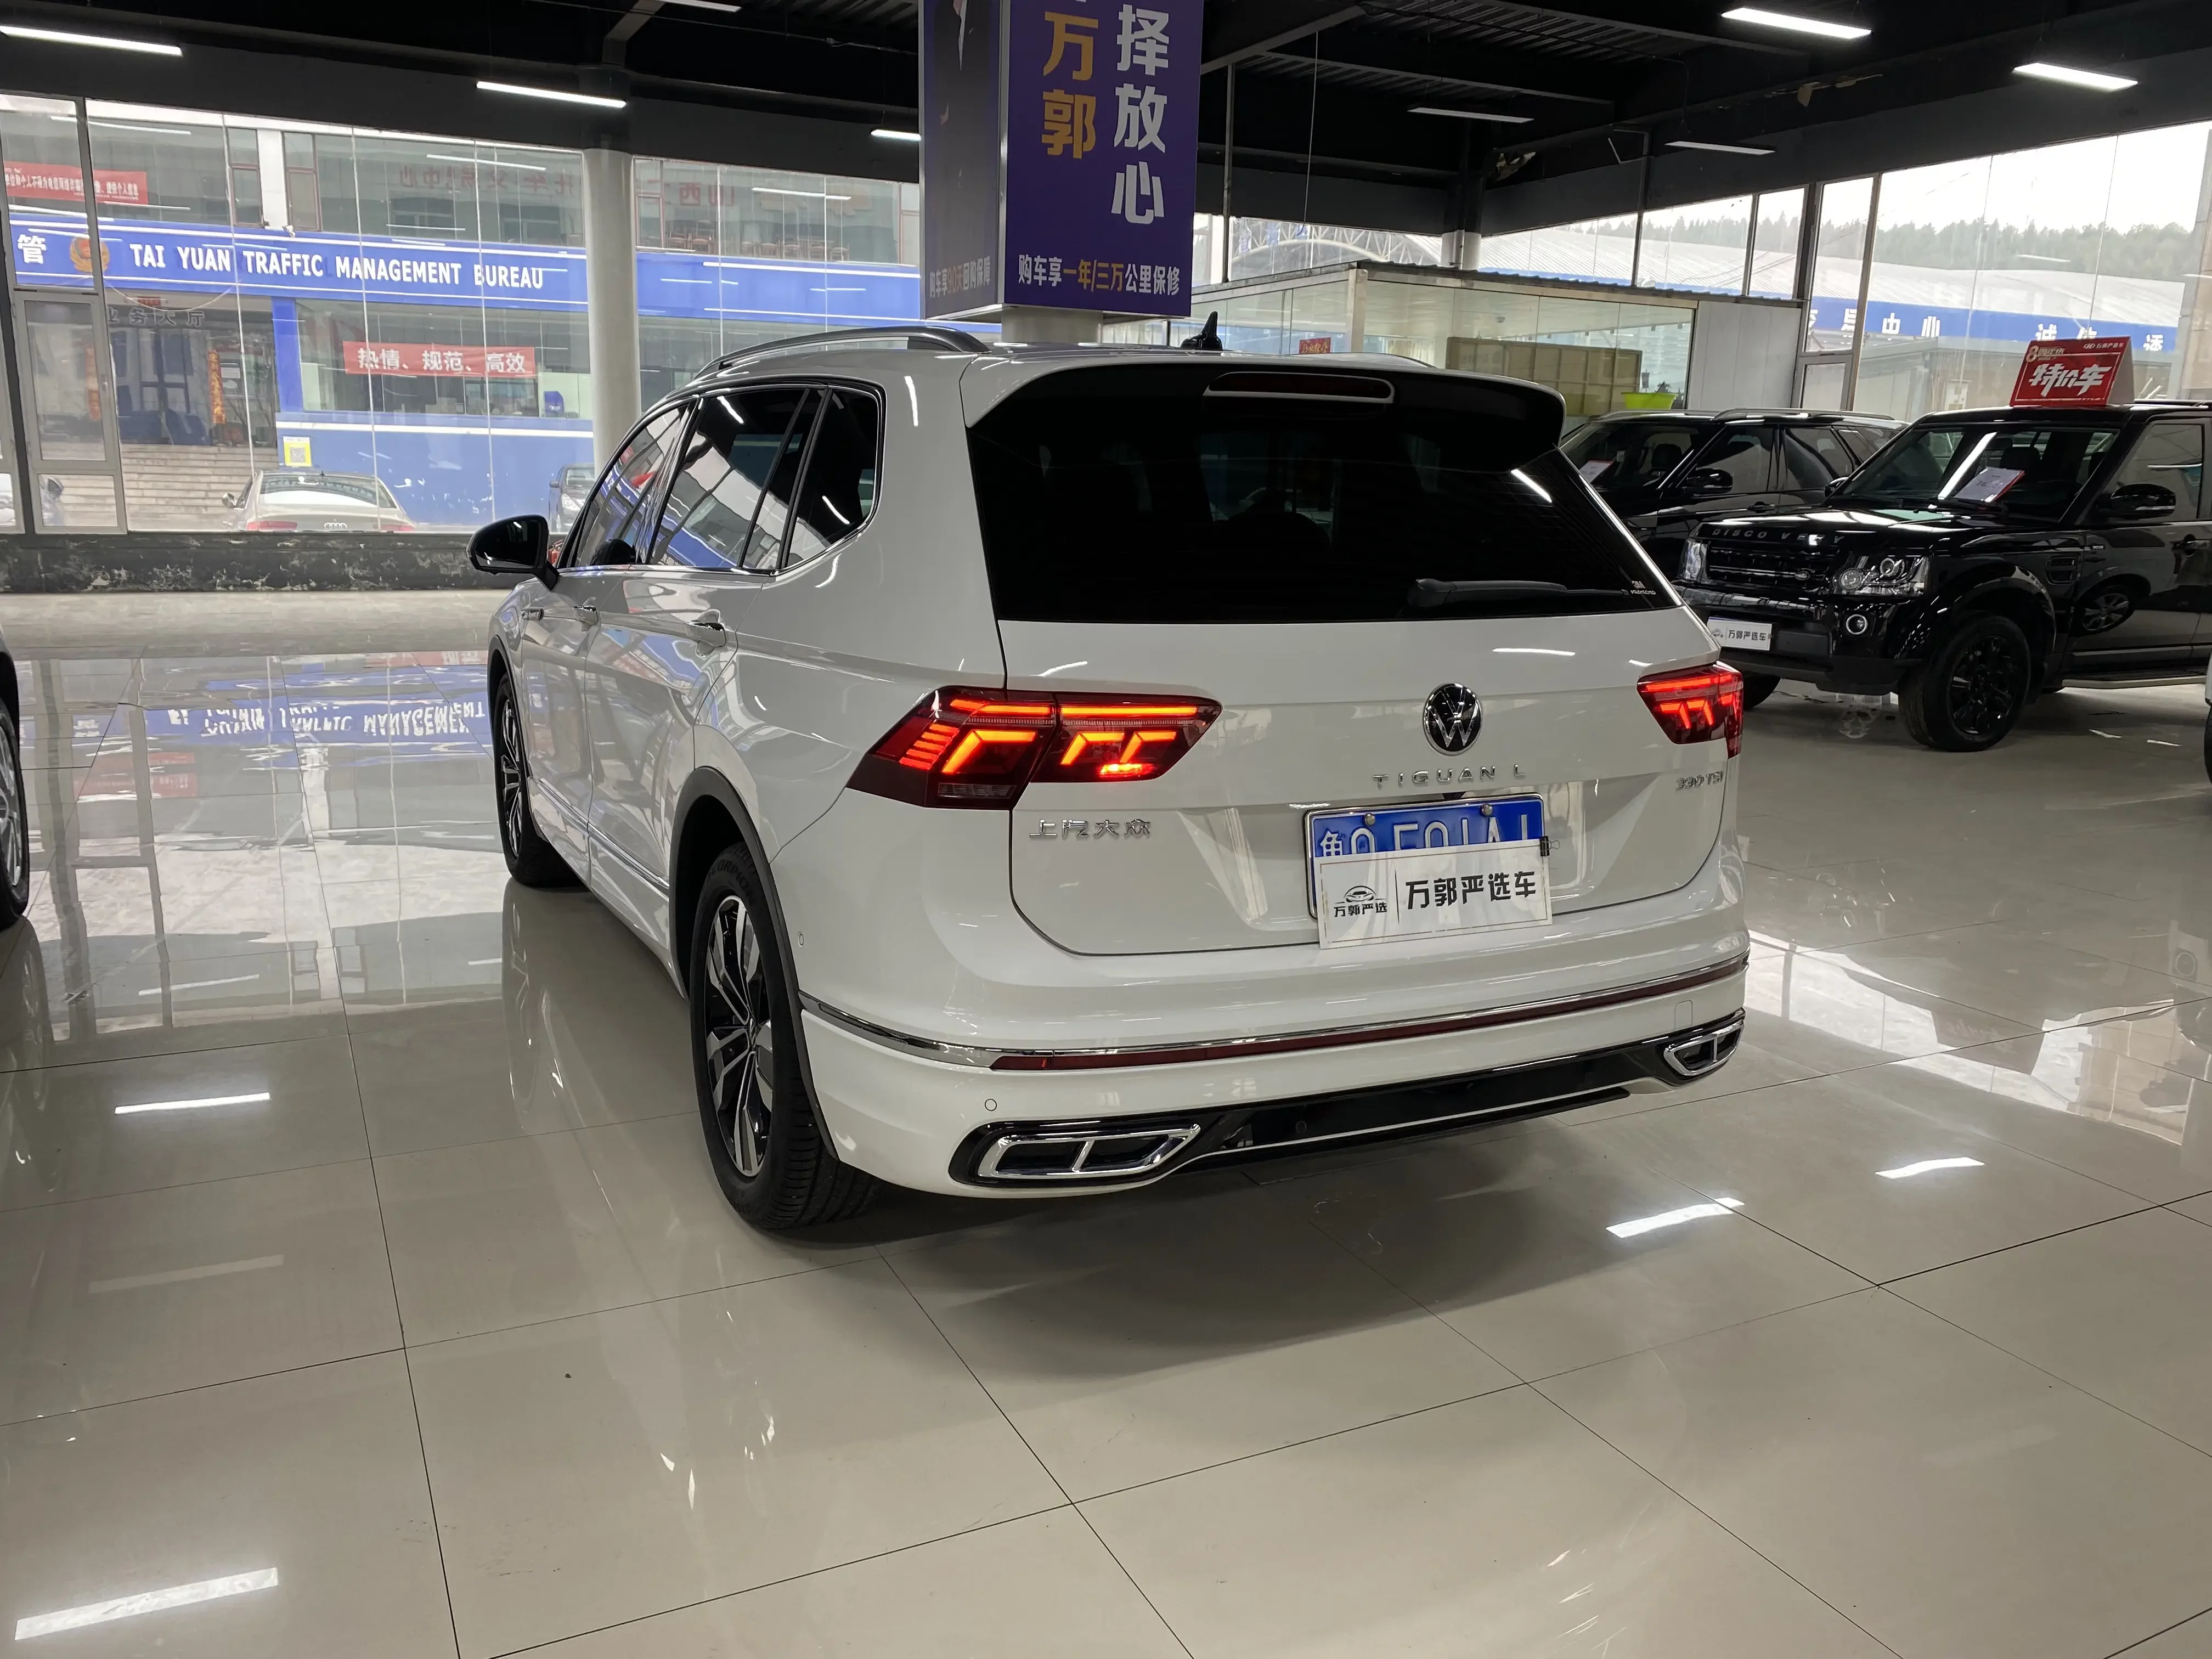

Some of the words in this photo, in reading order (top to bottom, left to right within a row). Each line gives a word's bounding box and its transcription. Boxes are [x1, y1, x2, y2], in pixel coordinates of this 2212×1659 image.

[1040, 11, 1099, 159] 万郭
[1110, 3, 1170, 225] 择放心
[16, 234, 47, 264] 管
[129, 244, 166, 269] TAI
[177, 247, 231, 273] YUAN
[243, 251, 324, 277] TRAFFIC
[336, 256, 461, 285] MANAGEMENT
[474, 264, 544, 290] BUREAU
[1018, 254, 1181, 296] 购车享一年/三万公里保修
[2029, 363, 2112, 397] 特价车
[1372, 765, 1497, 789] TIGUAN
[1513, 763, 1526, 778] L
[1029, 819, 1152, 839] 上汽大众
[1404, 871, 1537, 910] 万郭严选车
[1333, 901, 1388, 918] 万郭严选
